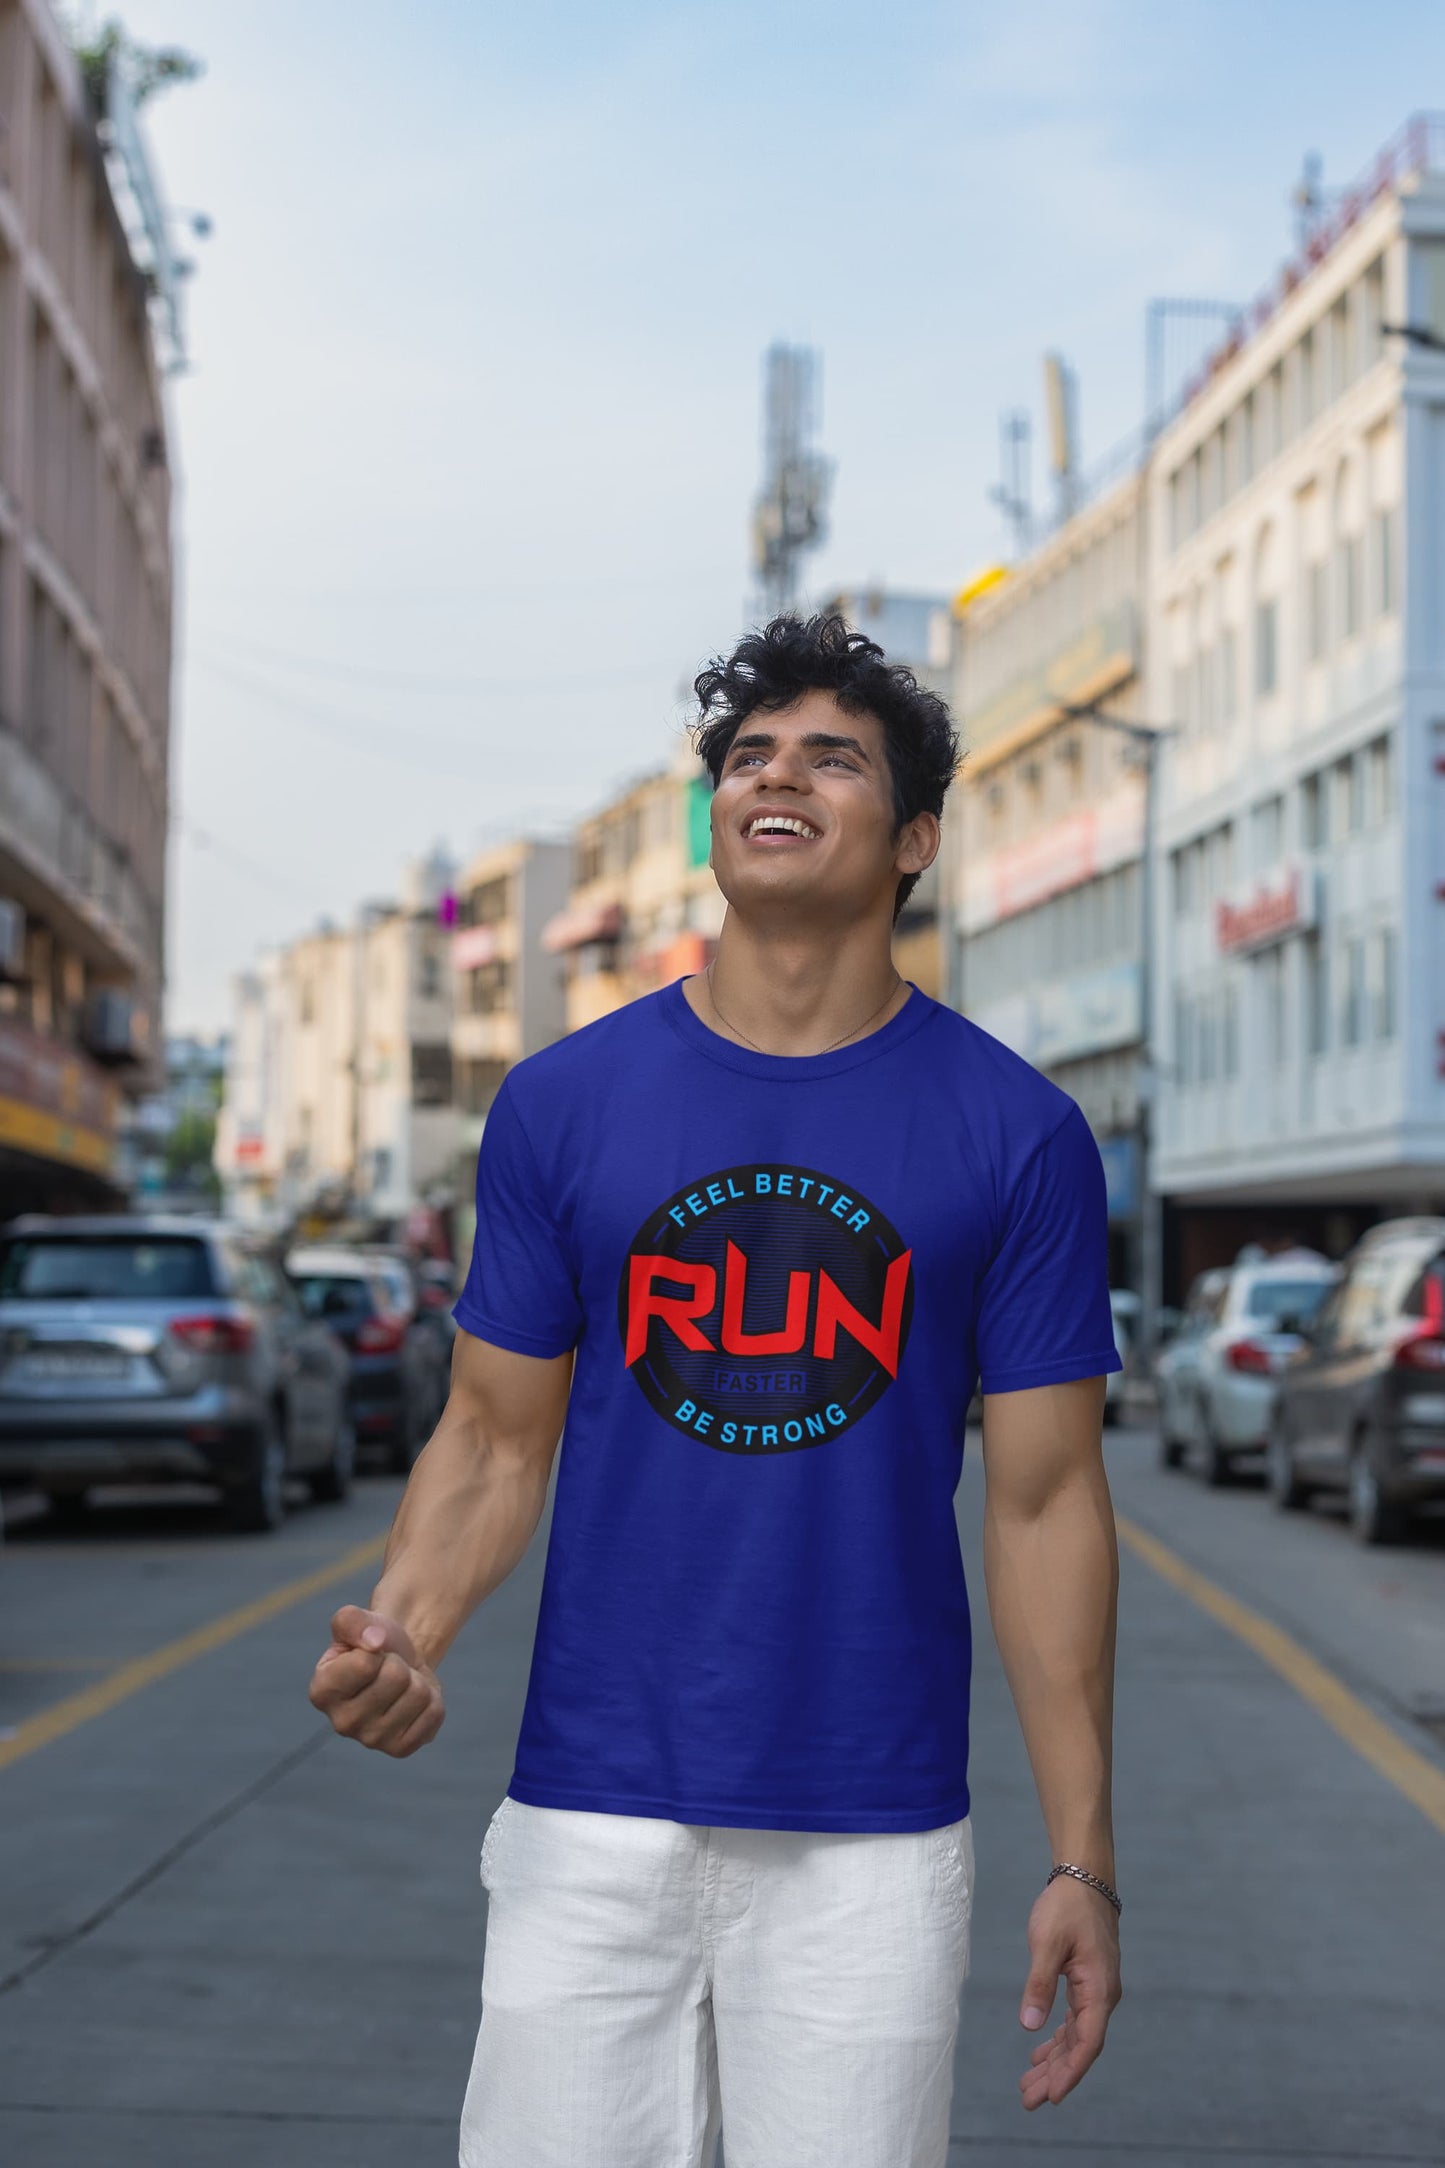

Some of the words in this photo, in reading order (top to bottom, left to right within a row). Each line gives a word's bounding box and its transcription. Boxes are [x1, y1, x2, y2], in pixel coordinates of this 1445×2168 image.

[668, 1178, 744, 1228] FEEL
[755, 1173, 871, 1233] BETTER
[625, 1239, 912, 1381] RUN
[716, 1372, 804, 1392] FASTER
[674, 1399, 714, 1434] BE
[720, 1403, 848, 1445] STRONG
